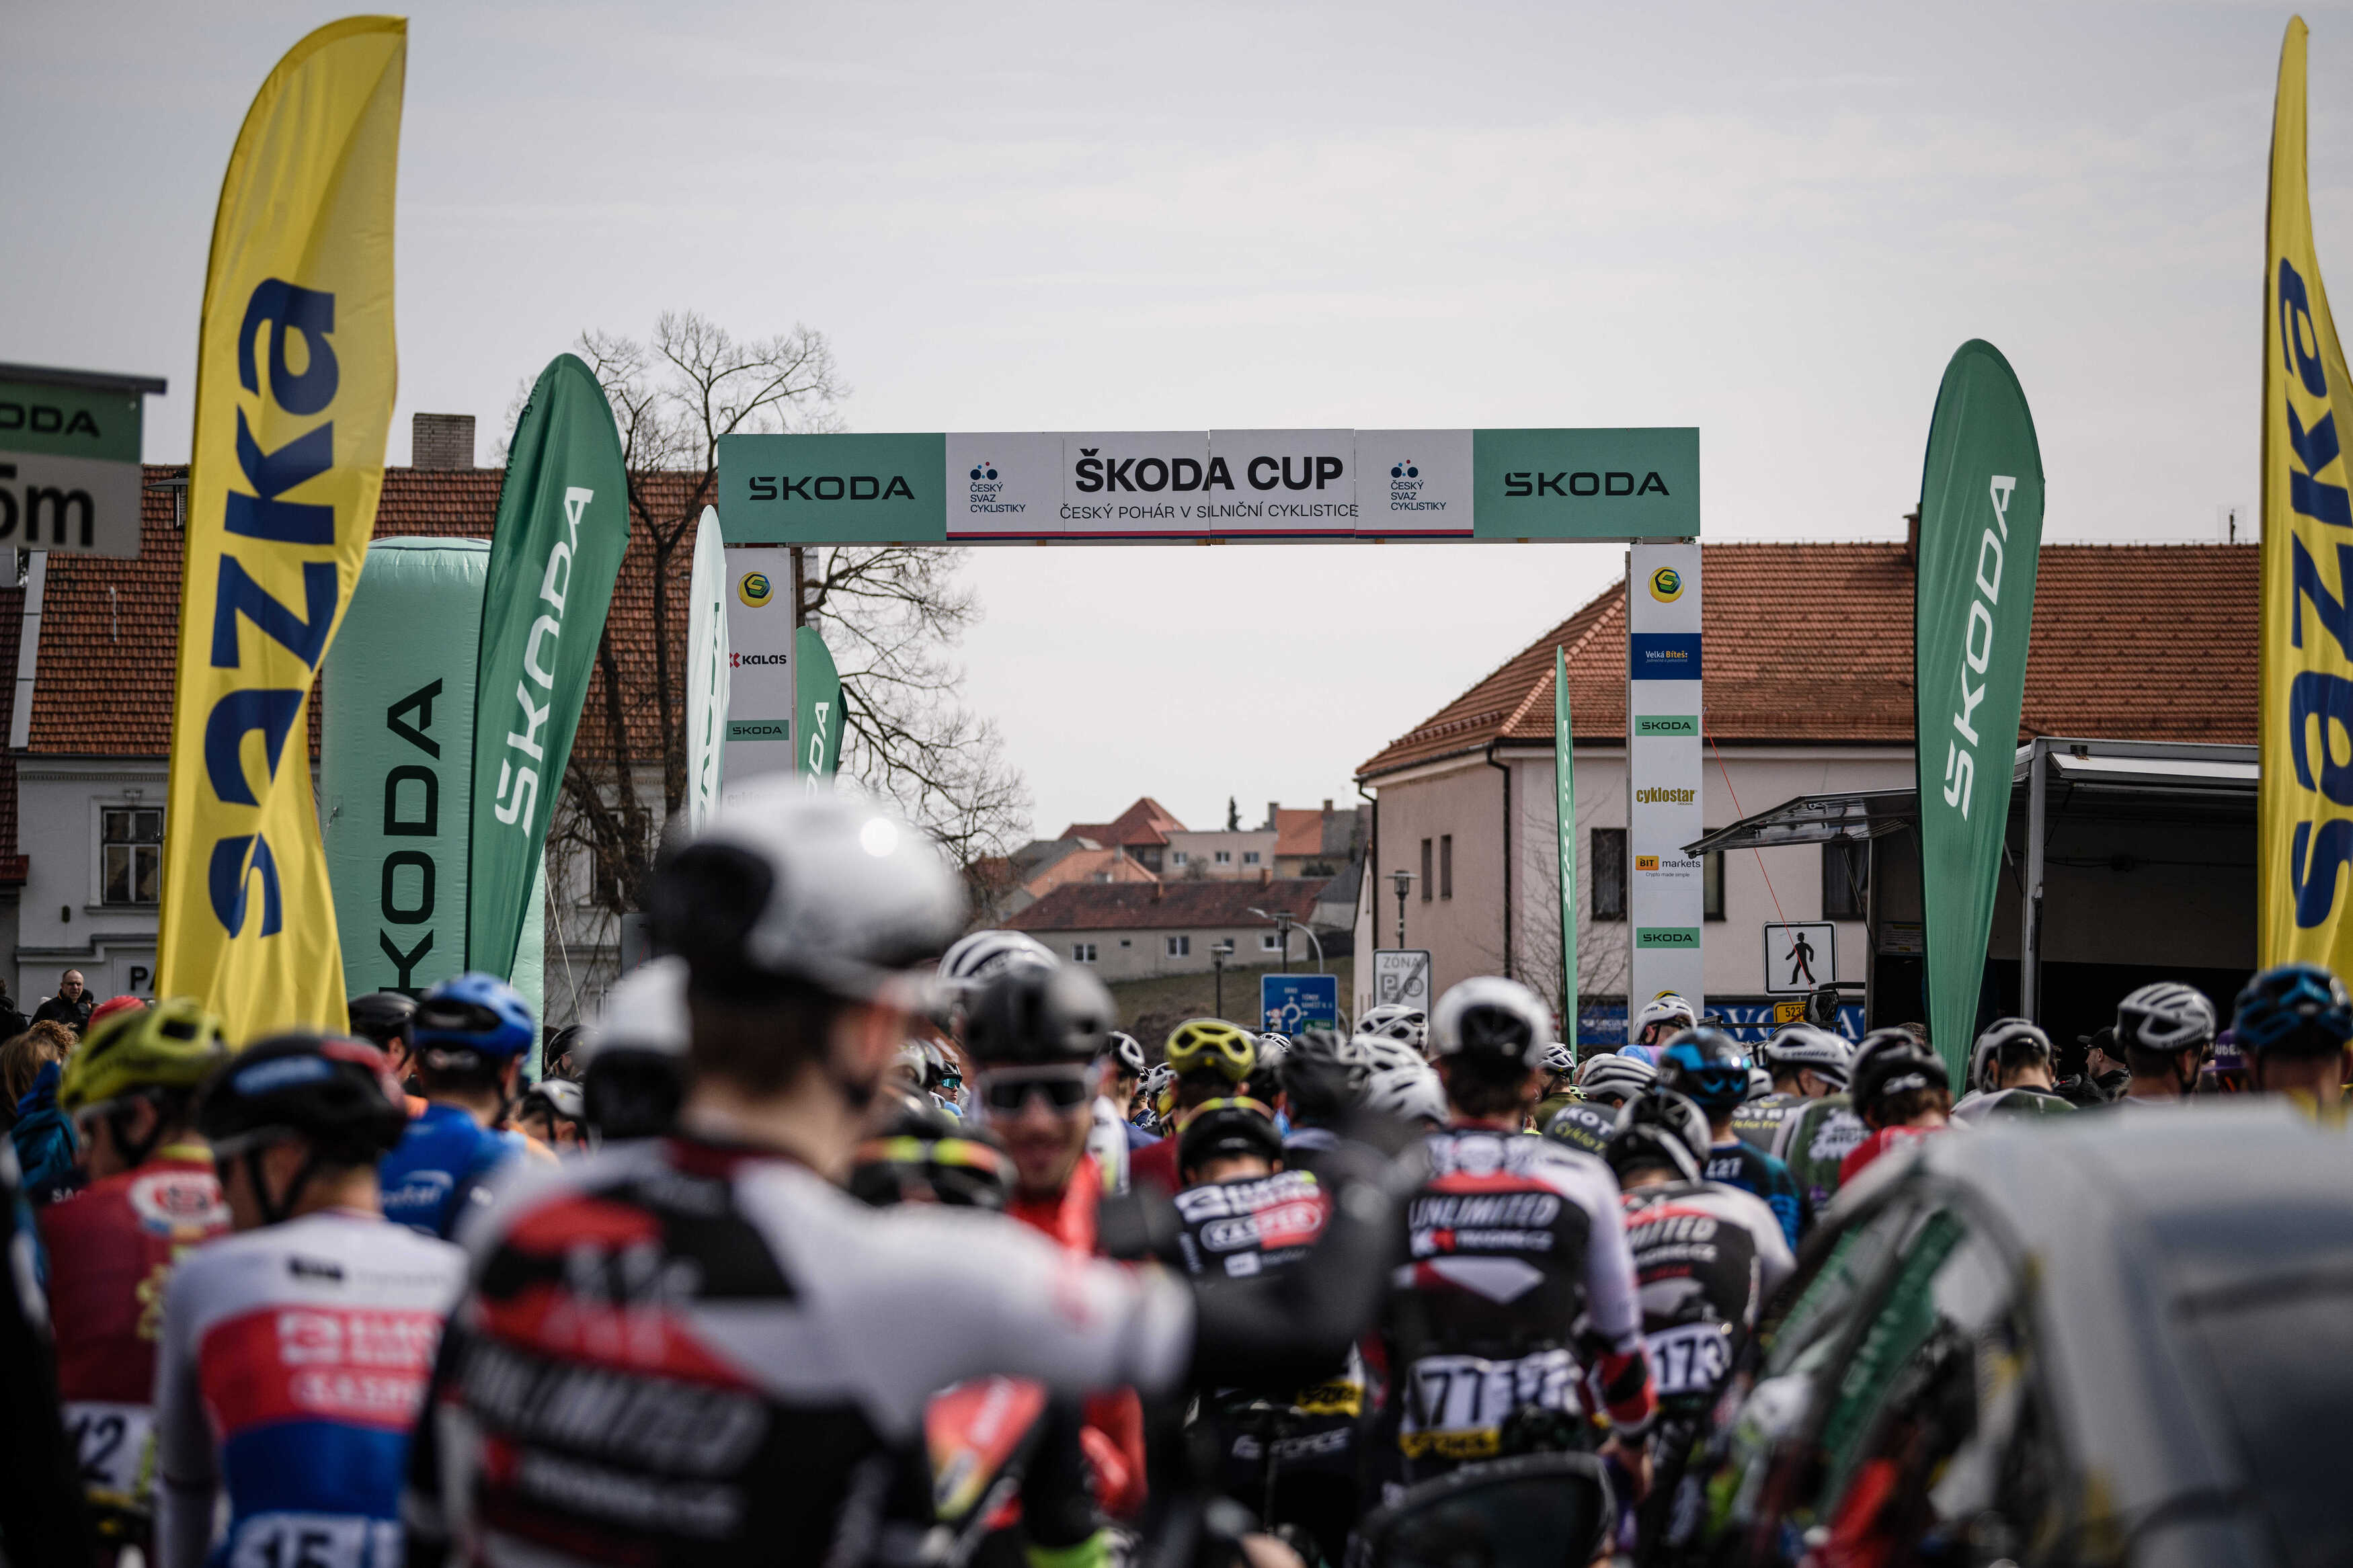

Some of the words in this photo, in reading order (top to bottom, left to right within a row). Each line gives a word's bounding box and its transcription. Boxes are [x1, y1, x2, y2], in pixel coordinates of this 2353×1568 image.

[1075, 448, 1236, 493] ŠKODA
[1247, 456, 1343, 491] CUP
[970, 481, 1004, 492] ČESKÝ
[1390, 479, 1424, 491] ČESKÝ
[970, 494, 996, 503] SVAZ
[1390, 492, 1417, 501] SVAZ
[970, 504, 1026, 513] CYKLISTIKY
[1060, 503, 1113, 520] ČESKÝ
[1119, 502, 1174, 519] POHÁR
[1181, 506, 1191, 518] V
[1197, 501, 1263, 518] SILNIČNÍ
[1268, 503, 1359, 518] CYKLISTICE
[1390, 502, 1447, 511] CYKLISTIKY
[205, 278, 340, 940] sazka
[1636, 787, 1695, 803] cyklostar
[1662, 860, 1701, 868] markets
